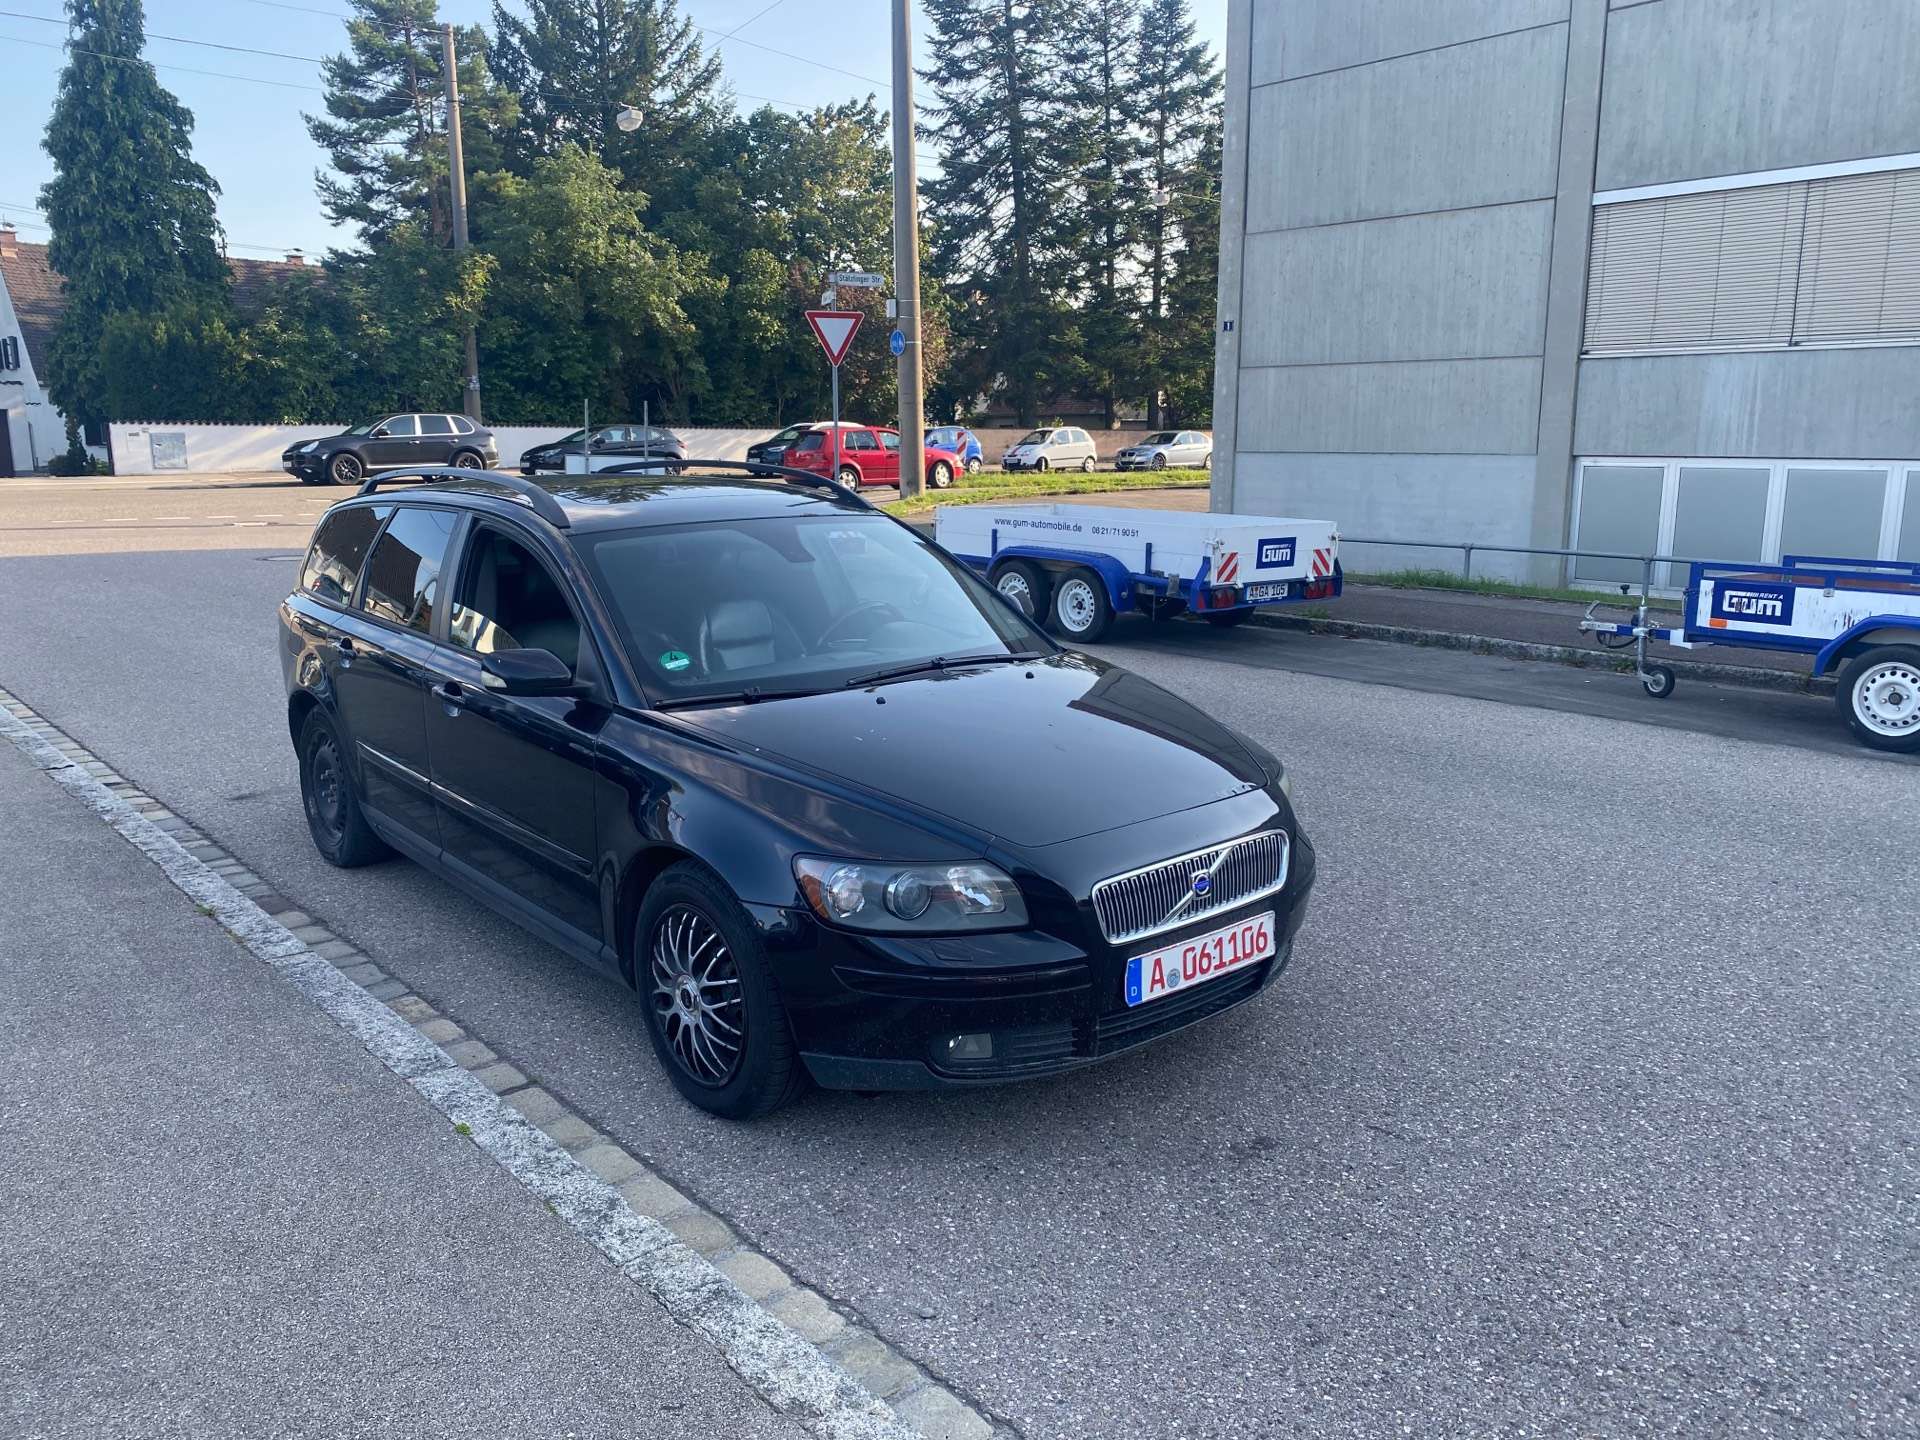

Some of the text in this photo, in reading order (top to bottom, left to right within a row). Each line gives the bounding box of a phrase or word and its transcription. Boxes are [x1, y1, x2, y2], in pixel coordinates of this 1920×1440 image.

[994, 518, 1082, 532] www.gum-automobile.de
[1150, 922, 1268, 992] A 061106
[1131, 986, 1137, 997] D
